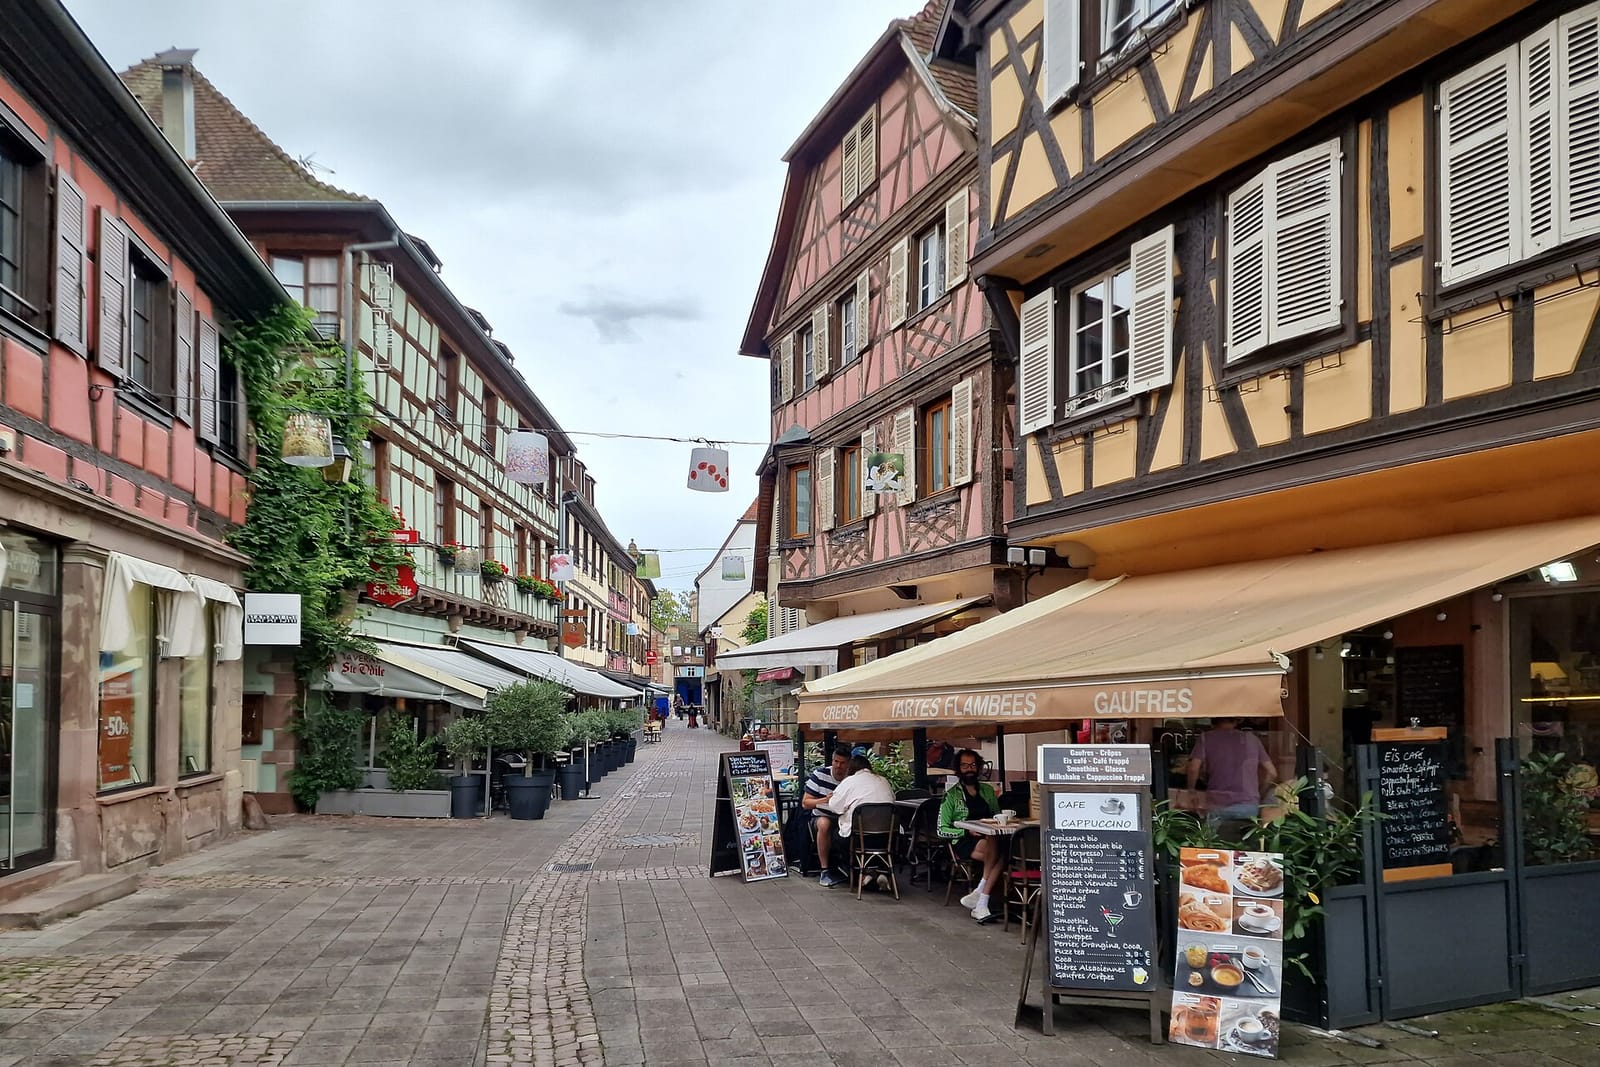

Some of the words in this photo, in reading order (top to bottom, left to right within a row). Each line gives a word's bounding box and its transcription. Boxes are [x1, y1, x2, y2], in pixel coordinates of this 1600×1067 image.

[341, 661, 357, 675] Ste
[358, 662, 385, 677] Odile
[822, 704, 860, 721] CREPES
[891, 697, 942, 719] TARTES
[944, 692, 1037, 717] FLAMBEES
[1094, 687, 1193, 715] GAUFRES
[104, 716, 129, 738] -50%
[1070, 749, 1094, 757] Gaufres
[1100, 749, 1122, 758] Crêpes
[1063, 757, 1072, 765] Eis
[1073, 757, 1087, 765] café
[1093, 757, 1107, 765] Café
[1108, 757, 1130, 766] frappé
[1104, 765, 1127, 773] Glaces
[1086, 774, 1122, 782] Cappuccino
[1124, 774, 1146, 782] frappé
[1058, 801, 1086, 809] CAFE
[1061, 819, 1132, 829] CAPPUCCINO
[1050, 842, 1068, 850] pain
[1111, 842, 1123, 850] bio
[1051, 849, 1068, 858] Café
[1070, 850, 1104, 858] (expresso)
[1051, 857, 1068, 866] Café
[1080, 857, 1094, 865] lait
[1052, 864, 1094, 873] Cappuccino
[1138, 865, 1145, 873] €
[1053, 894, 1086, 904] Rallongé
[1053, 902, 1086, 910] Infusion
[1053, 916, 1089, 925] Smoothie
[1050, 925, 1066, 933] Jus
[1077, 925, 1100, 934] fruits
[1053, 932, 1093, 942] Schweppes
[1081, 941, 1120, 950] Orangina,
[1054, 964, 1078, 972] Bières
[1079, 964, 1126, 973] Alsaciennes
[1056, 972, 1086, 980] Gaufres
